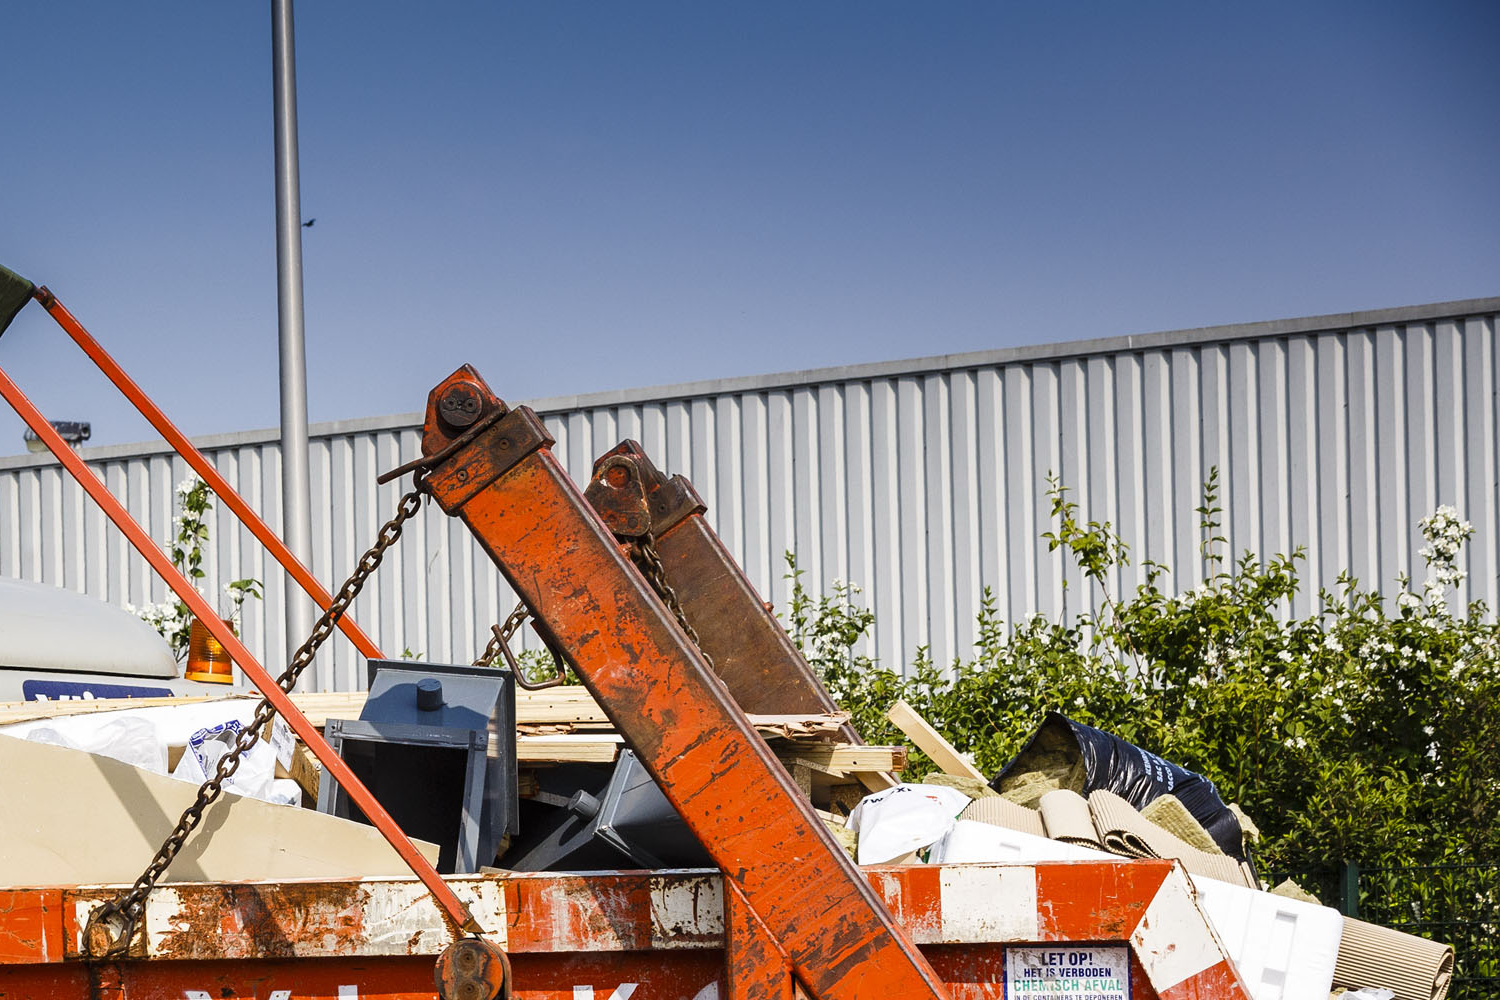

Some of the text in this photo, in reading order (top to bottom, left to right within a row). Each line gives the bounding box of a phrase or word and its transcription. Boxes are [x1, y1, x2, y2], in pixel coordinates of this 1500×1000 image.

[1041, 952, 1093, 965] LET OP!
[1024, 968, 1112, 977] HET IS VERBODEN
[1014, 979, 1123, 991] CHEMISCH AFVAL
